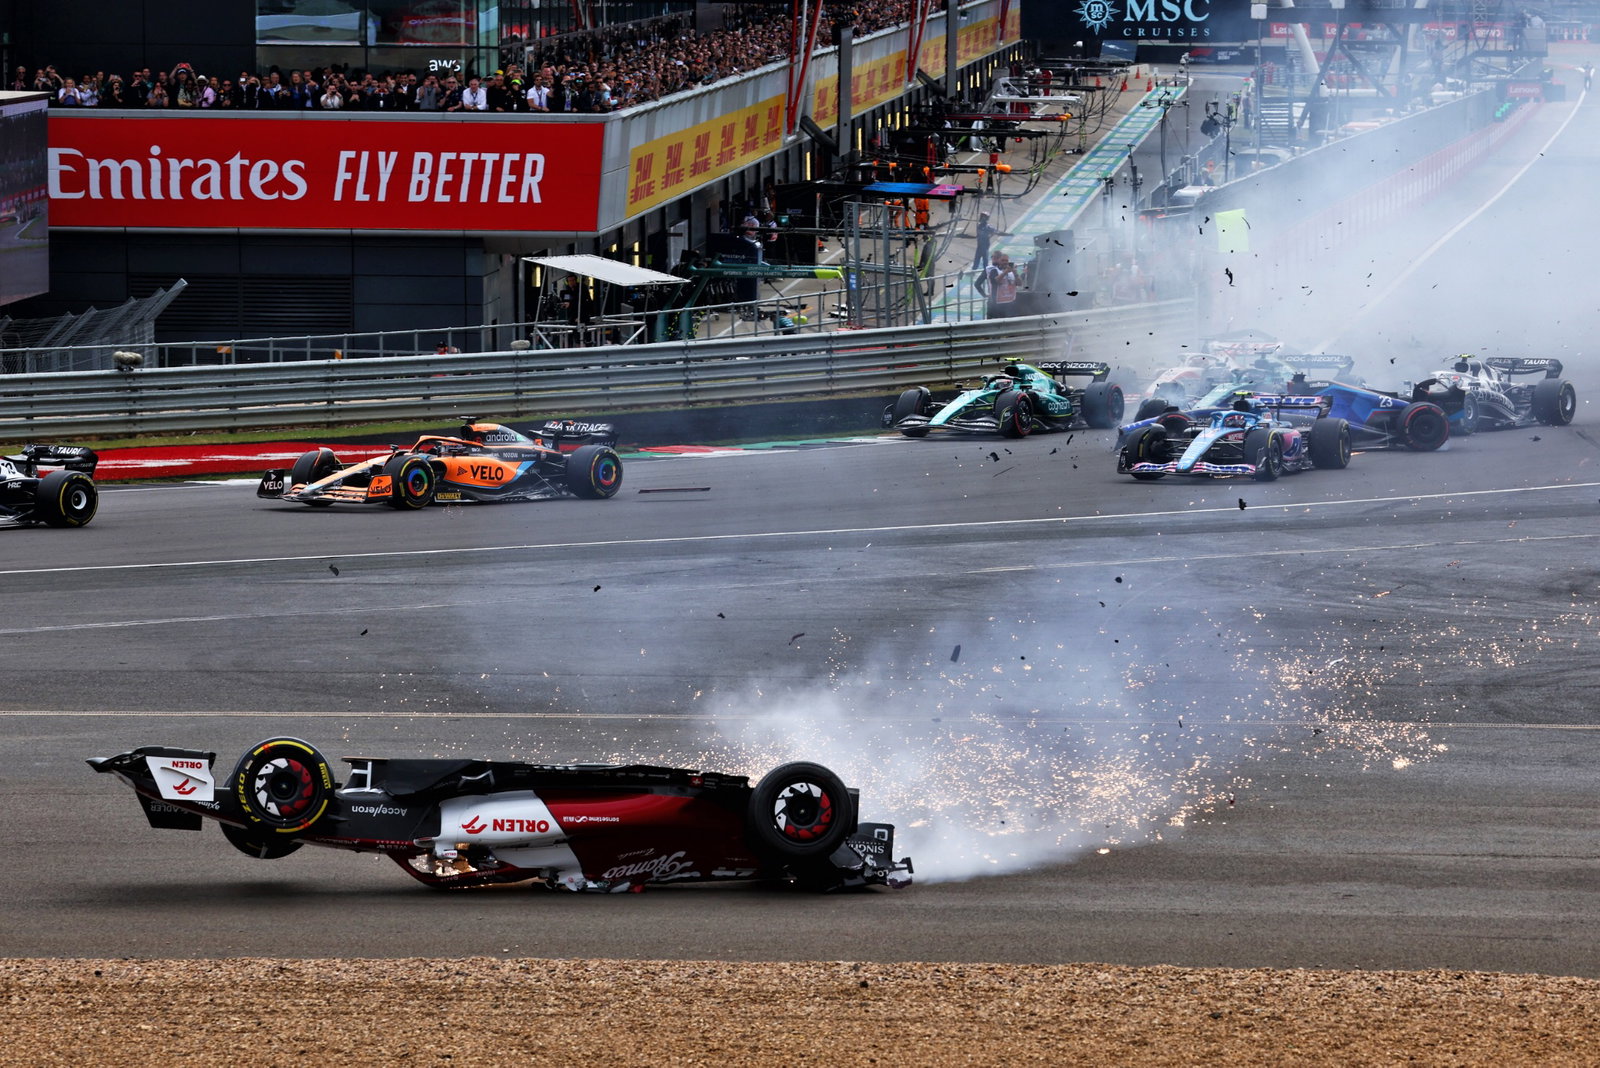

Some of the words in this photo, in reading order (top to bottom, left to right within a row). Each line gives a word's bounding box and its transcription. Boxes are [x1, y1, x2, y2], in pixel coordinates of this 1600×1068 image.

[1124, 0, 1209, 21] MSC
[1123, 28, 1210, 36] CRUISES
[429, 60, 461, 71] aws
[48, 145, 307, 200] Emirates
[334, 151, 398, 202] FLY
[408, 152, 545, 203] BETTER
[1379, 396, 1393, 408] 23
[486, 432, 516, 442] android
[57, 447, 83, 455] TAURI
[471, 465, 504, 481] VELO
[264, 480, 284, 490] VELO
[370, 485, 392, 494] VELO
[172, 761, 203, 769] ORLEN
[493, 819, 550, 833] ORLEN
